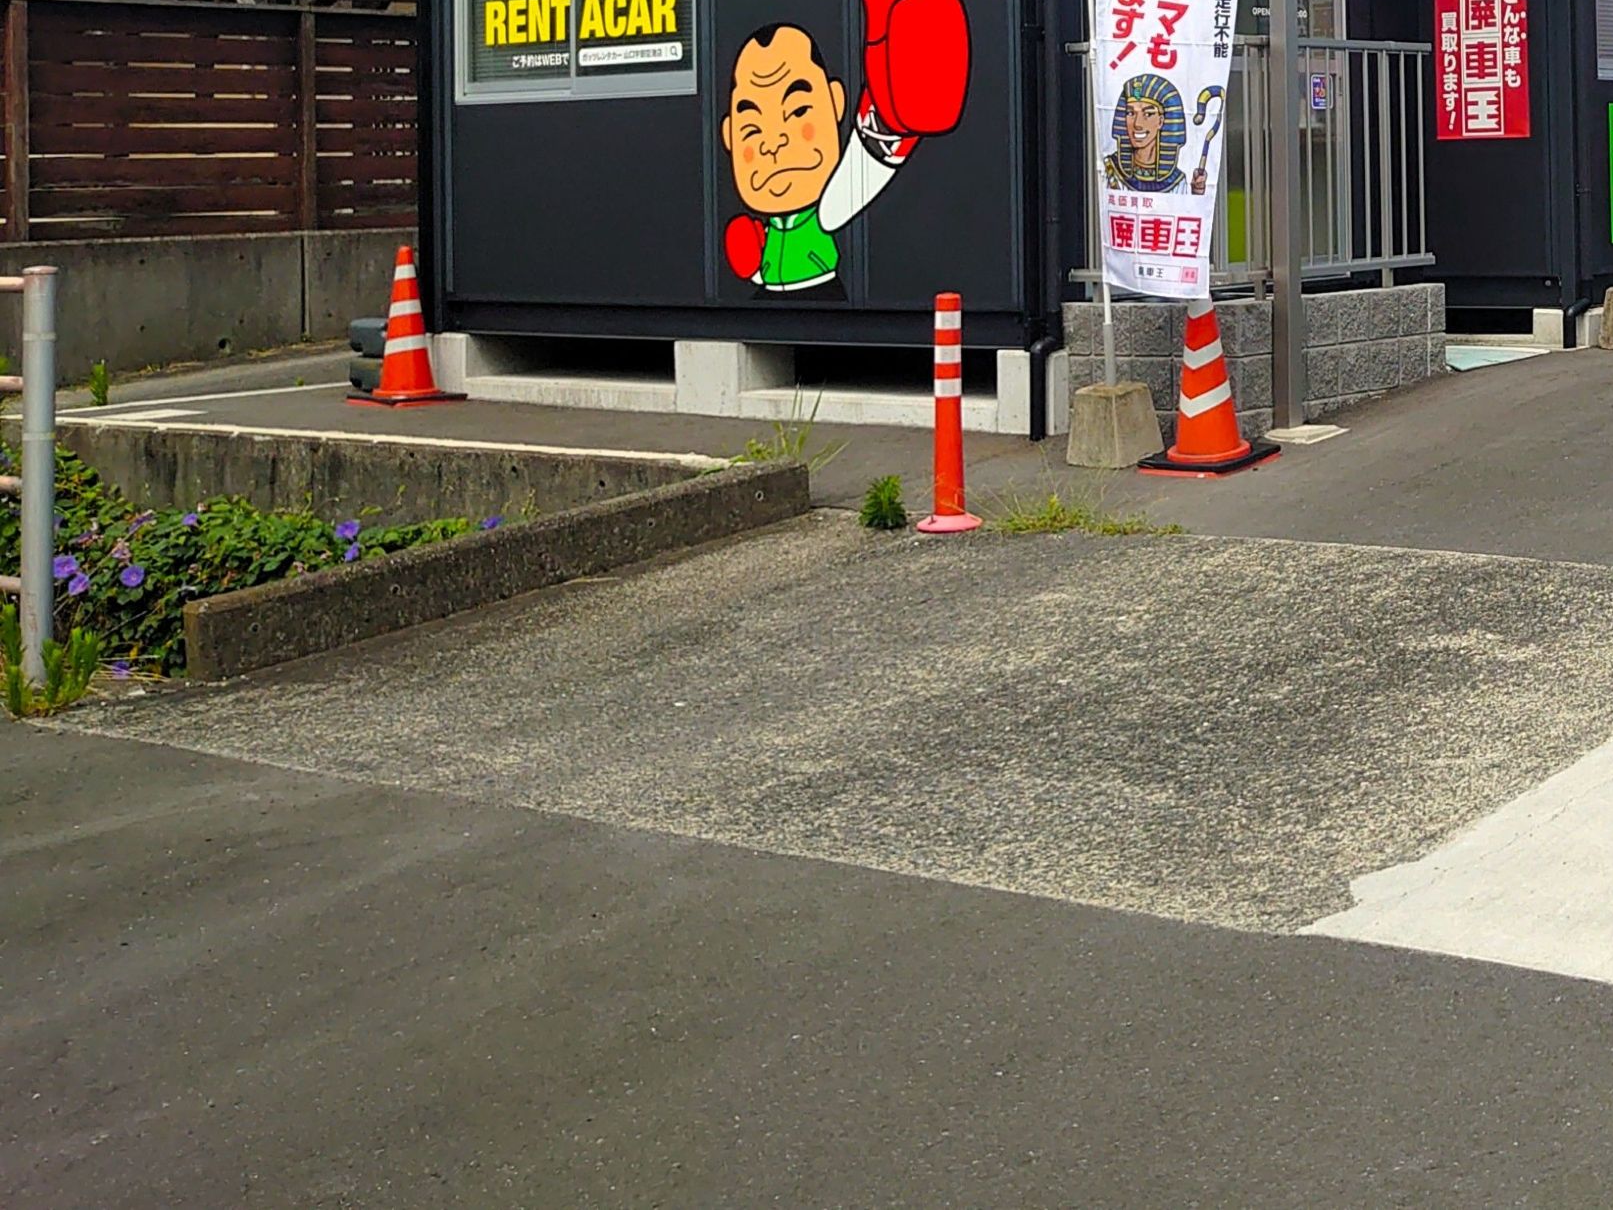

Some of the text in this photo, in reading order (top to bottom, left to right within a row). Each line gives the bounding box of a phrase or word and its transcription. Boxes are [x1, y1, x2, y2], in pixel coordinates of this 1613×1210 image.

[1440, 11, 1460, 131] 買取ります!
[1109, 212, 1202, 258] 廃車王
